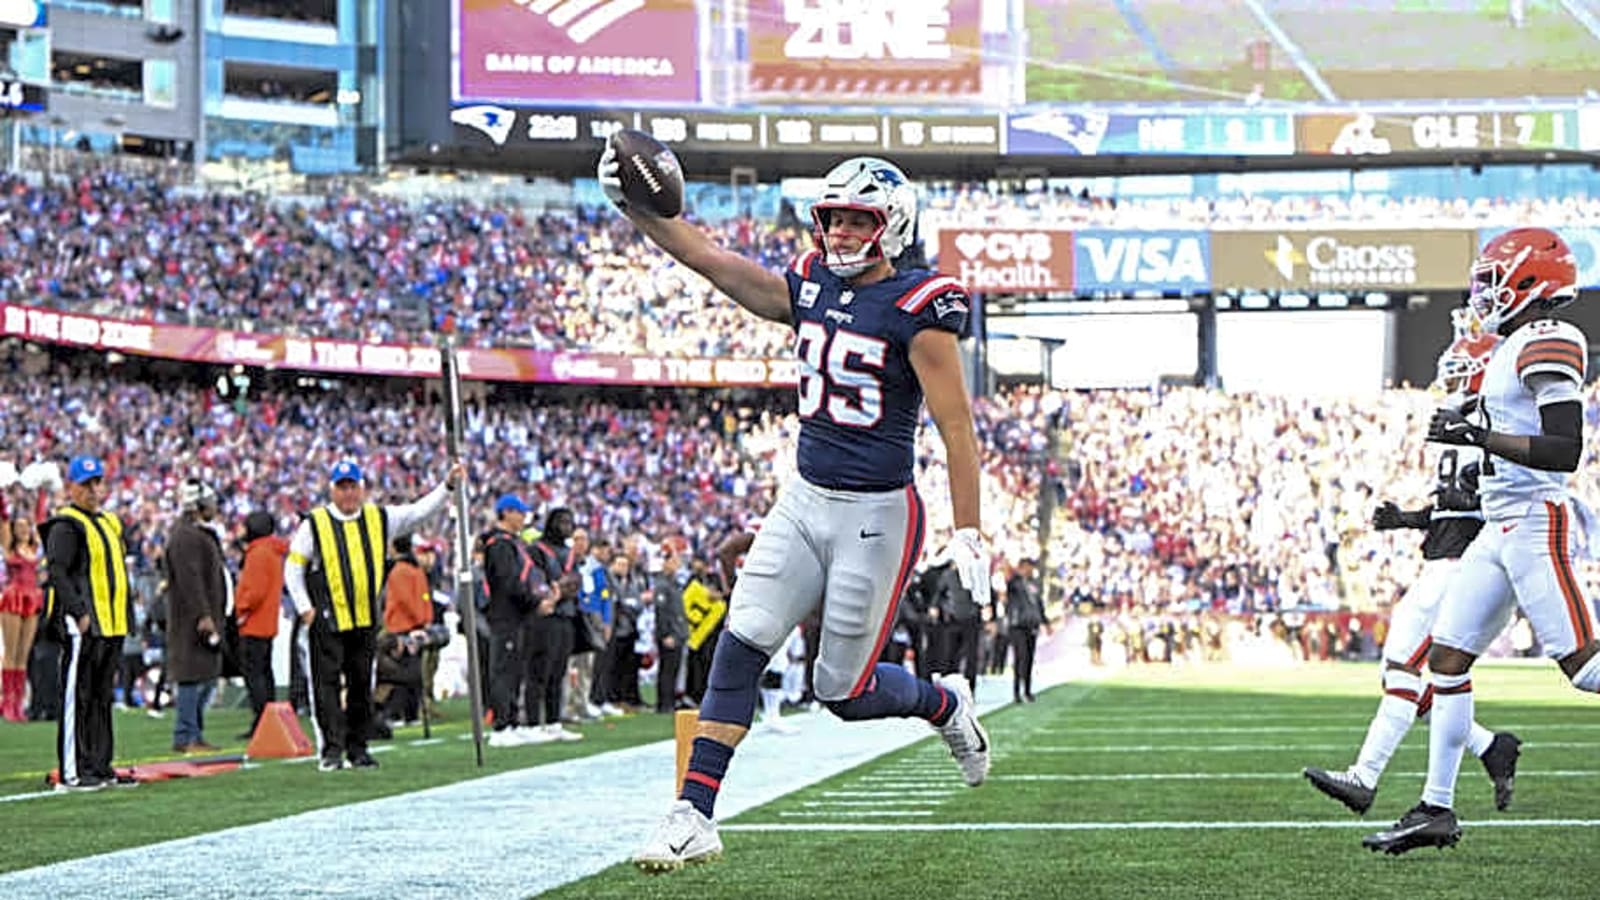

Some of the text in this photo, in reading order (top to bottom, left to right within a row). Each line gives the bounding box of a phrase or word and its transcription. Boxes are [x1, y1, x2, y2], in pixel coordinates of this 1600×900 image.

[785, 19, 951, 58] ZONE
[485, 53, 675, 77] BANK OF AMERICA
[1413, 115, 1478, 149] CLE
[959, 260, 1054, 288] Health
[1078, 238, 1207, 284] VISA
[101, 320, 152, 351] ZONE
[768, 362, 798, 383] ZO
[797, 321, 889, 429] 85
